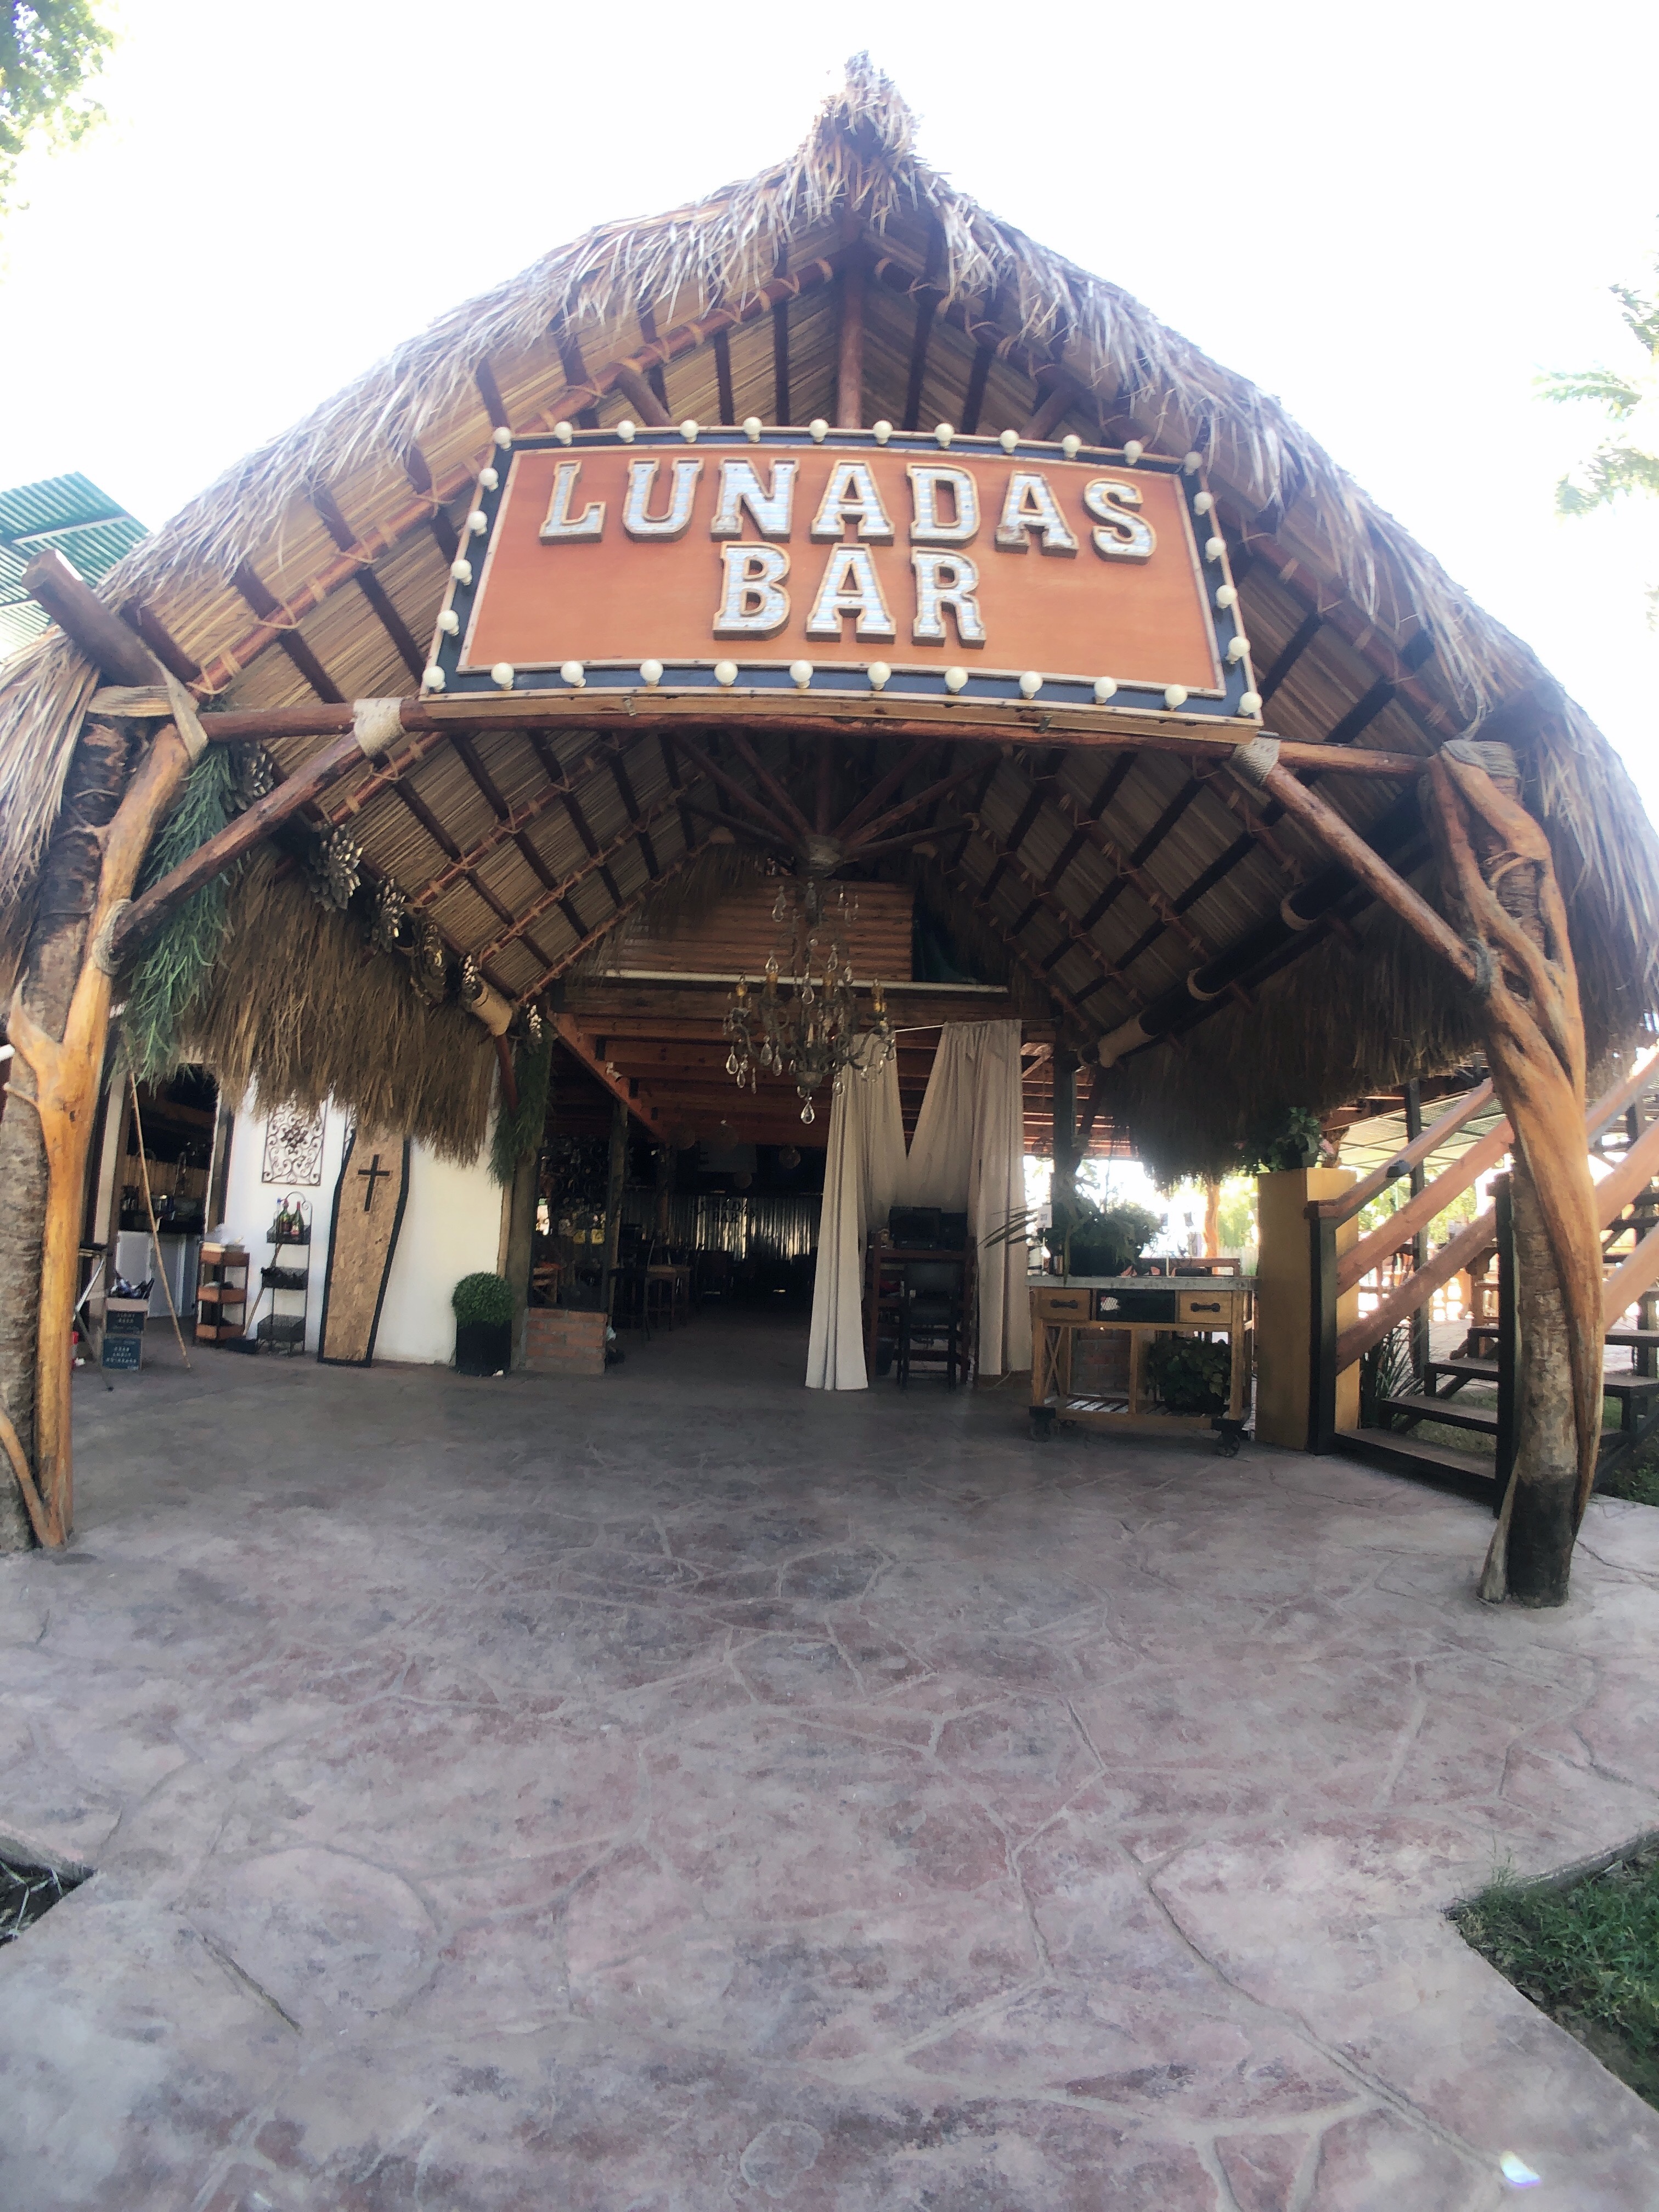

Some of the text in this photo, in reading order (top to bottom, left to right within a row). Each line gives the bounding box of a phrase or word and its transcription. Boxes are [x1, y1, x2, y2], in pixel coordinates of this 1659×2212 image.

[539, 458, 1157, 564] LUNADAS
[712, 540, 987, 649] BAR
[690, 1200, 758, 1218] ADAS
